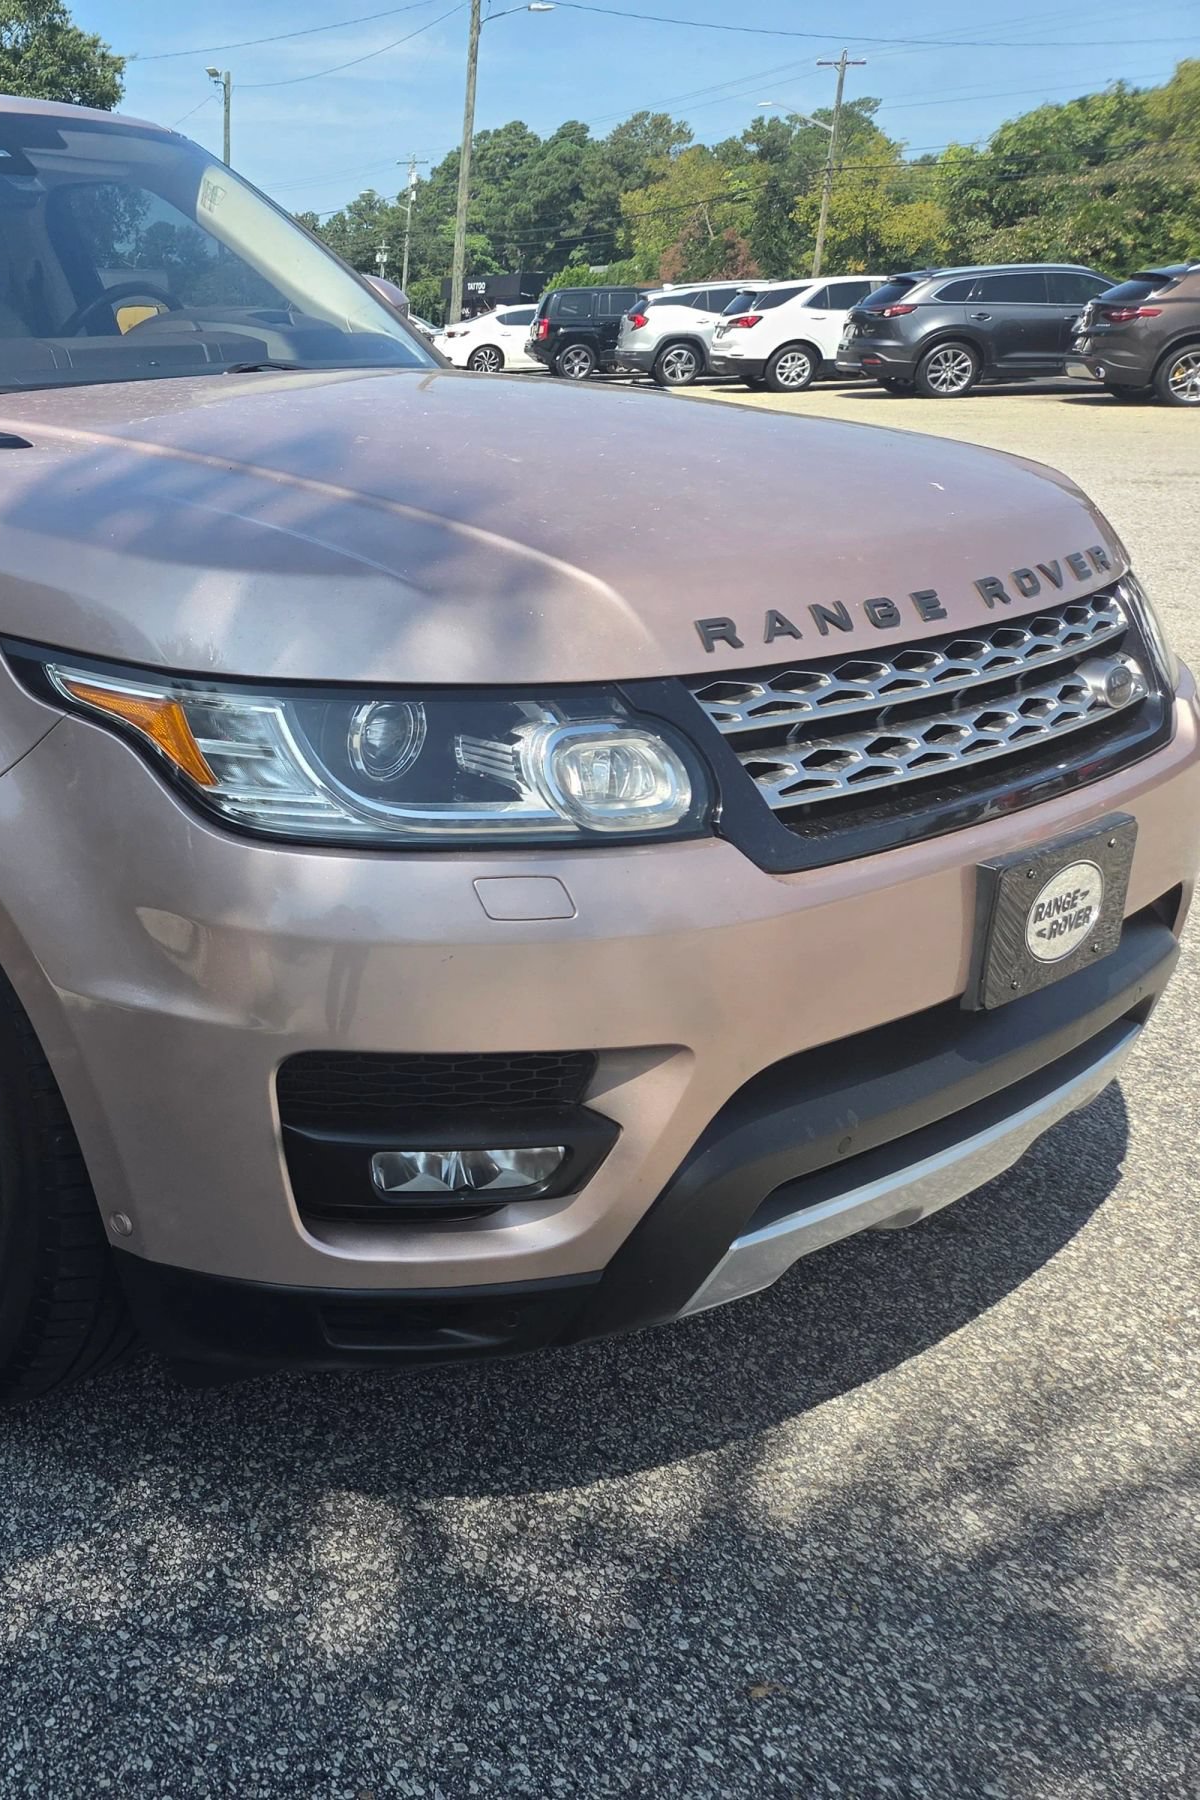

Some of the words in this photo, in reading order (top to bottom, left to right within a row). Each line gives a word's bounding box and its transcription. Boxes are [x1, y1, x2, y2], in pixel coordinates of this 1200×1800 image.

[694, 588, 949, 653] RANGE
[973, 545, 1112, 609] ROVER
[1033, 888, 1081, 924] RANGE
[1046, 905, 1093, 940] ROVER
